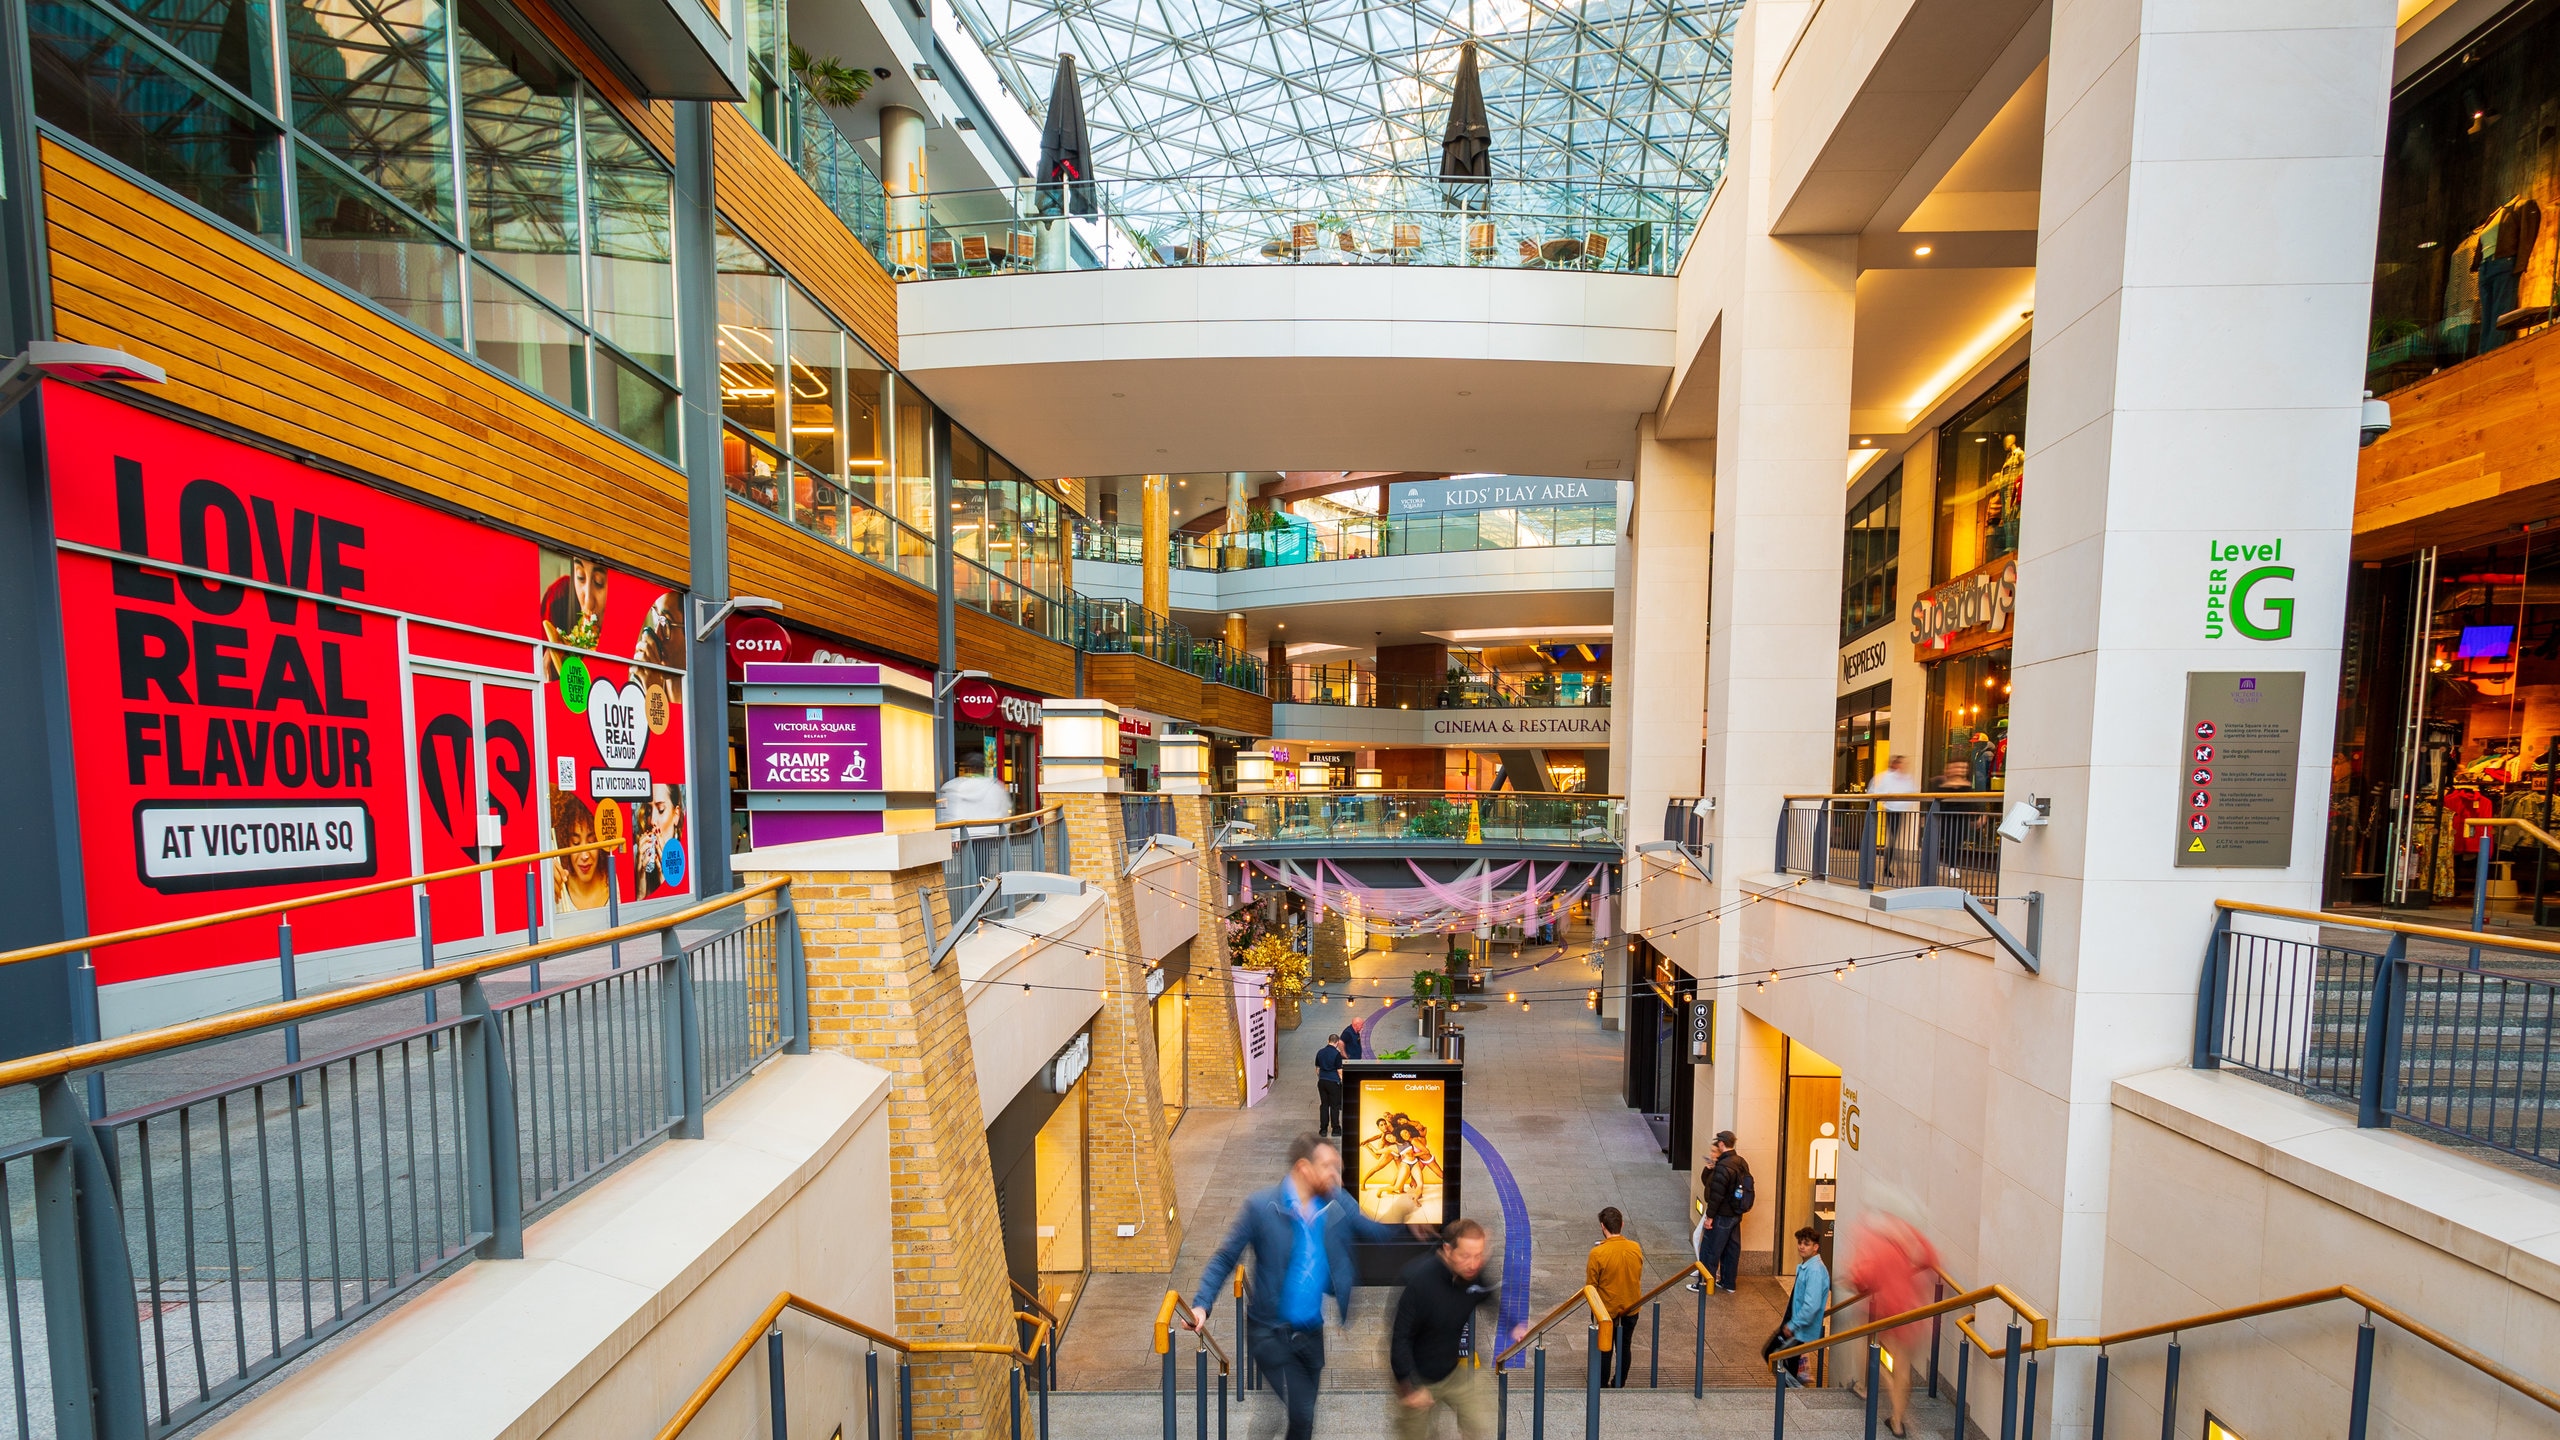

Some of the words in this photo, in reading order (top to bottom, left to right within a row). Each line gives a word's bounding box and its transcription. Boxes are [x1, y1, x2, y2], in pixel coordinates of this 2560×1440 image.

[1495, 485, 1538, 502] PLAY
[1541, 482, 1588, 499] AREA
[111, 455, 365, 637] LOVE
[2210, 538, 2282, 562] Level
[2205, 568, 2228, 639] UPPER
[2229, 566, 2295, 641] G
[735, 639, 783, 652] COSTA
[114, 608, 369, 719] REAL
[1841, 641, 1886, 685] NESPRESSO
[569, 665, 582, 676] LOVE
[568, 683, 584, 694] EVERY
[962, 695, 993, 705] COSTA
[604, 703, 635, 729] LOVE
[650, 708, 665, 718] COFFEE
[1001, 696, 1043, 728] COSTA
[774, 723, 819, 732] VICTORIA
[821, 723, 857, 733] SQUARE
[1434, 720, 1498, 734] CINEMA
[1502, 719, 1516, 732] &
[1519, 719, 1611, 732] RESTAURAN
[605, 729, 636, 746] REAL
[122, 711, 373, 787] FLAVOUR
[606, 746, 636, 760] FLAVOUR
[780, 753, 830, 767] RAMP
[1313, 754, 1340, 763] FRASERS
[766, 768, 830, 782] ACCESS
[596, 777, 604, 789] AT
[605, 777, 636, 790] VICTORIA
[637, 778, 647, 791] SQ
[602, 809, 615, 818] LOVE
[601, 818, 617, 827] KATSU
[601, 826, 617, 835] CATCH
[162, 825, 195, 860] AT
[201, 821, 319, 858] VICTORIA
[325, 817, 354, 854] SQ
[666, 851, 677, 859] LOVE
[1842, 1083, 1858, 1104] Level
[1846, 1104, 1860, 1152] G
